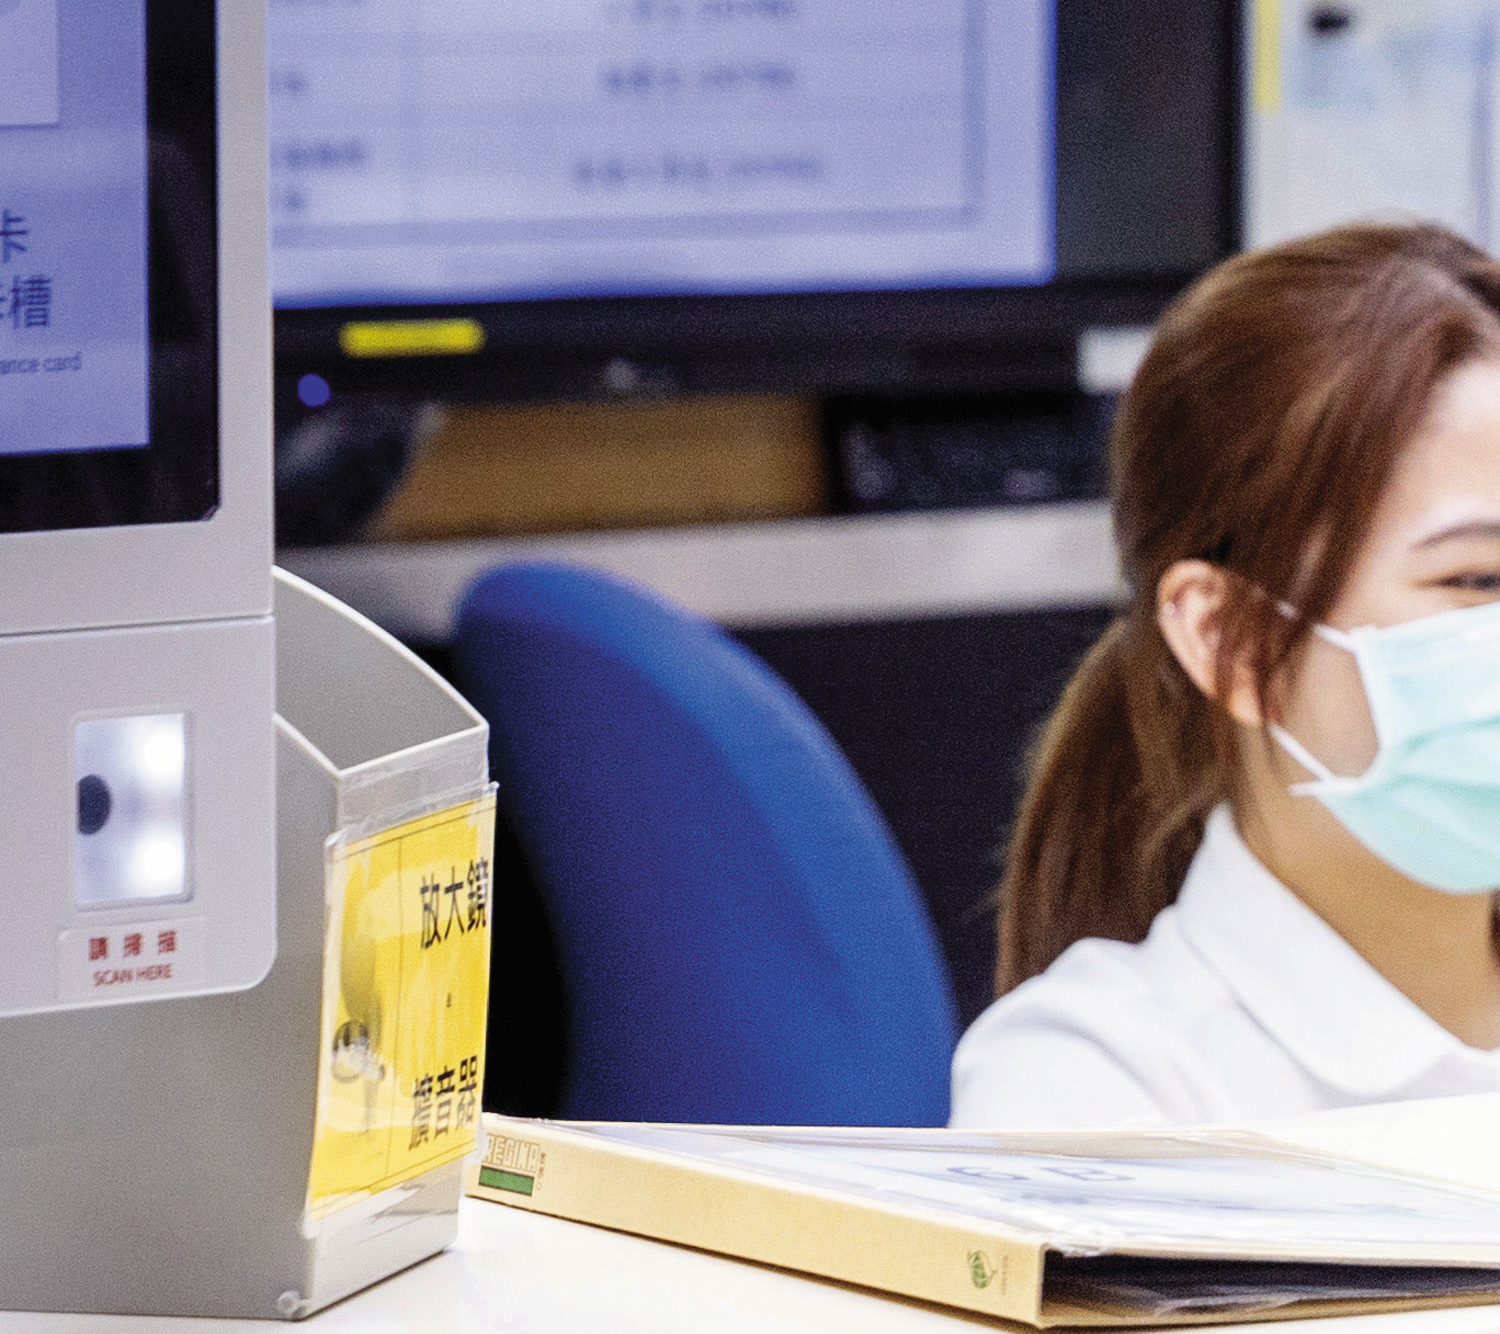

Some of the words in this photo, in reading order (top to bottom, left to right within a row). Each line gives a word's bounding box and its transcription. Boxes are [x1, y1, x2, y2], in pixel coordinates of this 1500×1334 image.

[0, 274, 51, 330] 槽
[420, 857, 489, 950] 放大鏡
[136, 962, 173, 982] HERE
